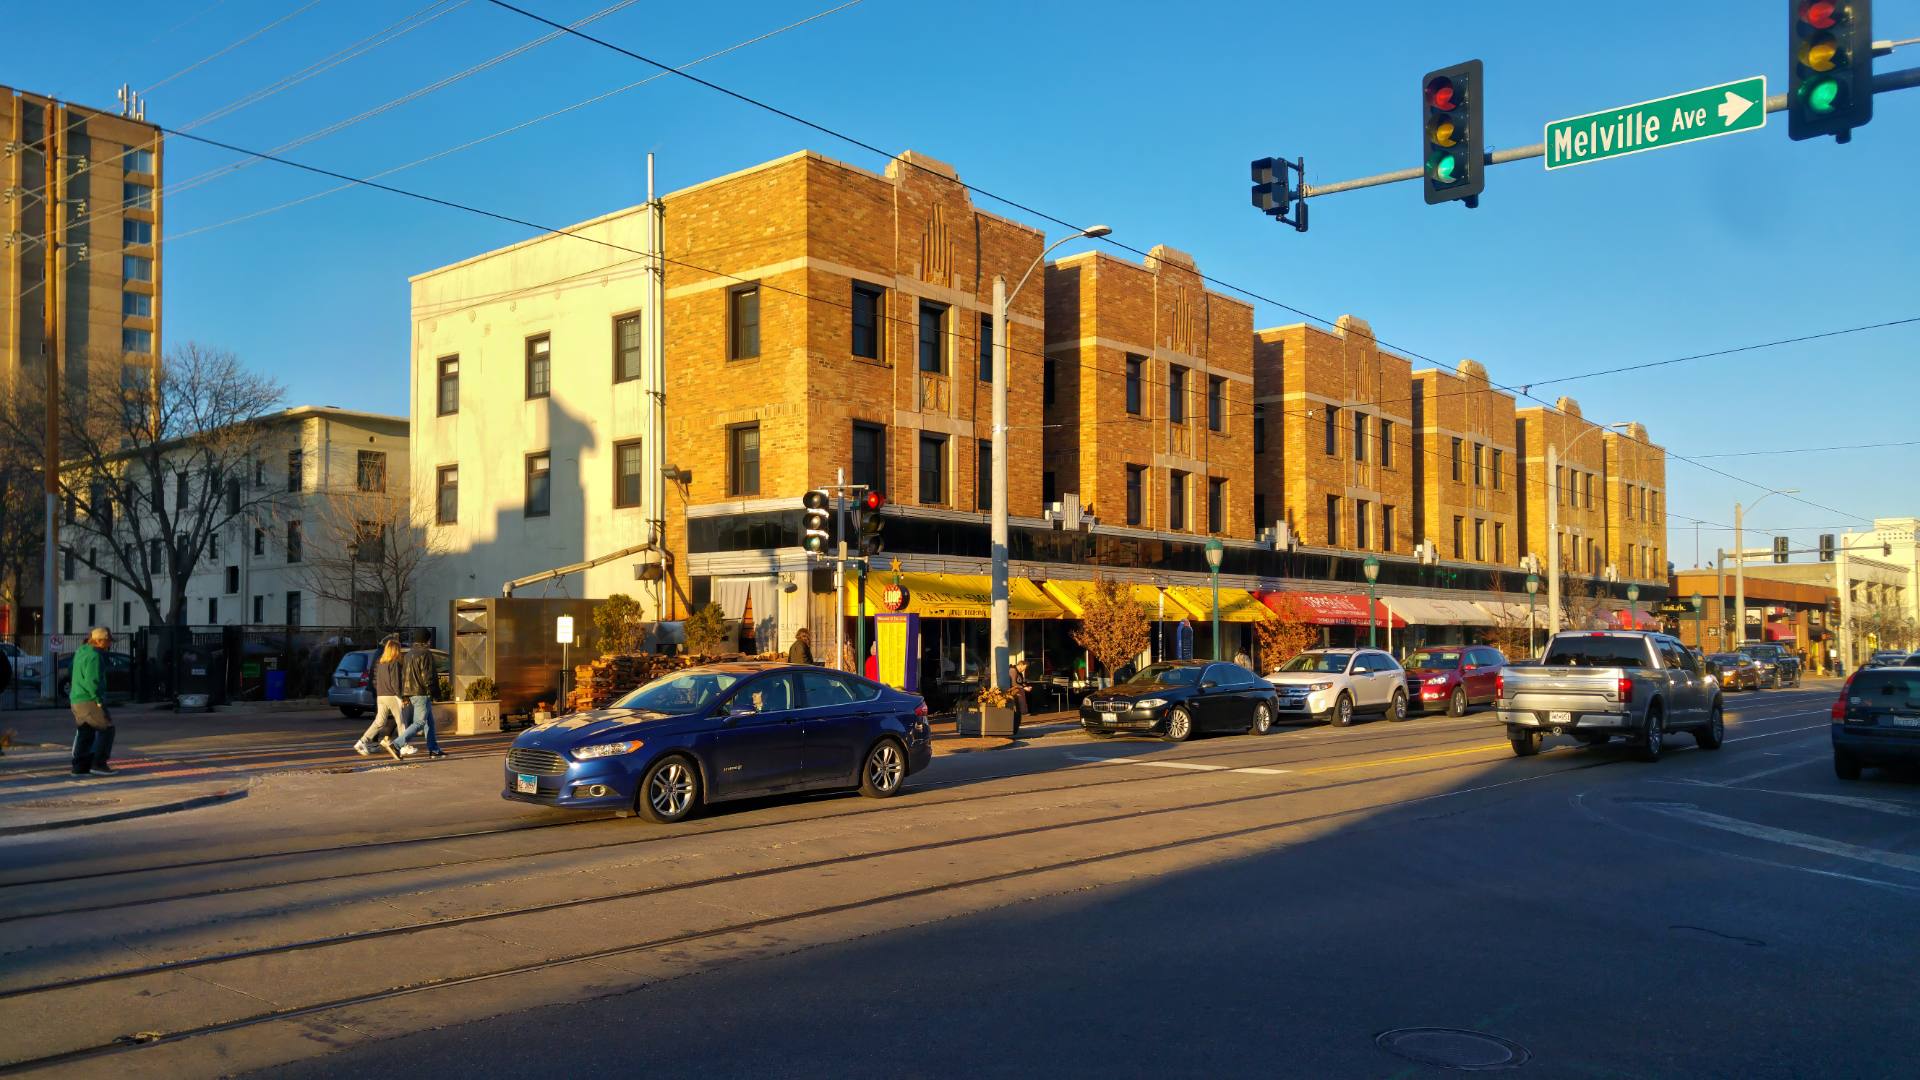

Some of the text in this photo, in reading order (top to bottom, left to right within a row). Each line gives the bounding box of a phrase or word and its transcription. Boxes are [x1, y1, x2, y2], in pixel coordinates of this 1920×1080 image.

[1554, 107, 1707, 162] Melville Ave
[884, 590, 902, 603] LOOP
